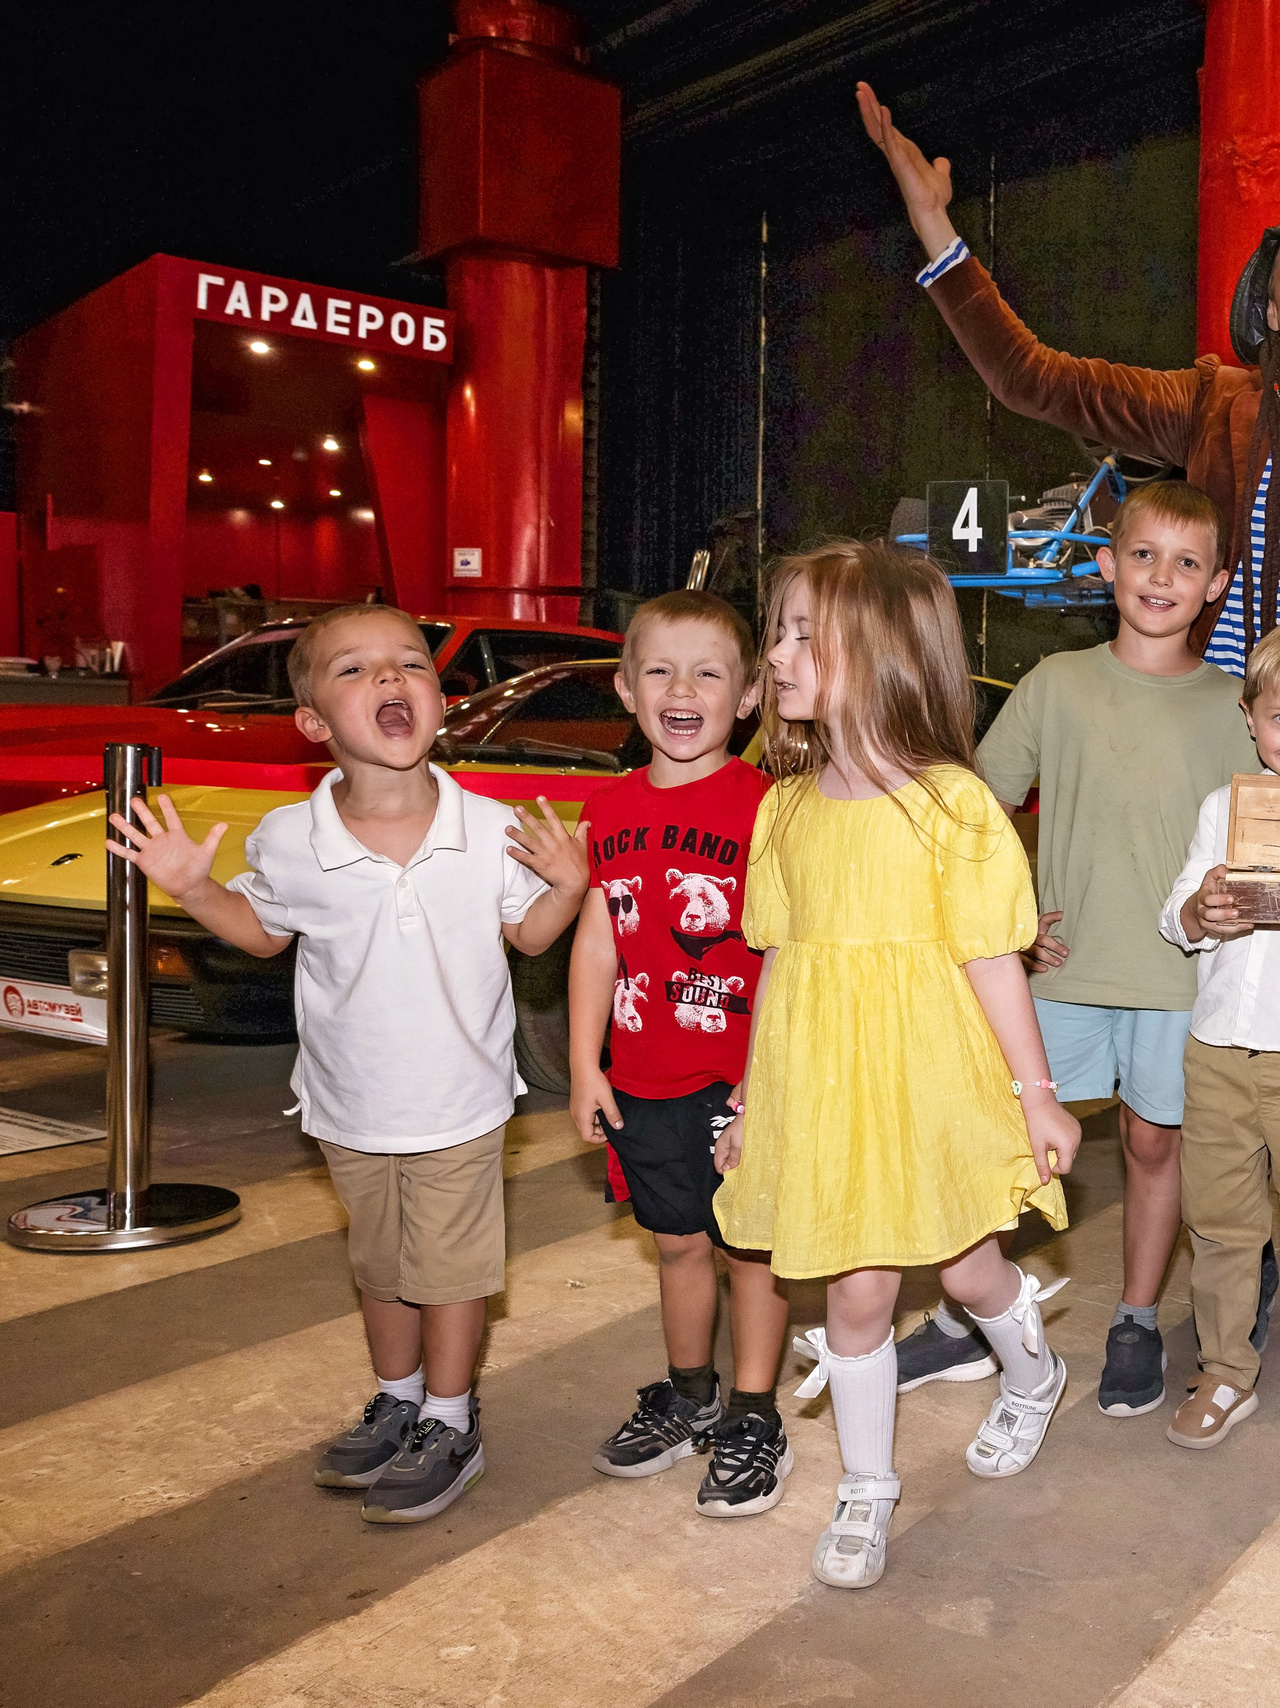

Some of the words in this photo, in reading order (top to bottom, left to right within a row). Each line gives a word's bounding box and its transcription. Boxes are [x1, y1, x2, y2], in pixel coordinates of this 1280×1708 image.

[197, 273, 447, 352] ГАРДЕРОБ
[952, 487, 983, 553] 4
[661, 825, 739, 866] BAND
[687, 967, 723, 991] BEST
[27, 999, 83, 1017] АВТОМУЗЕЙ
[670, 983, 730, 1009] SOUND
